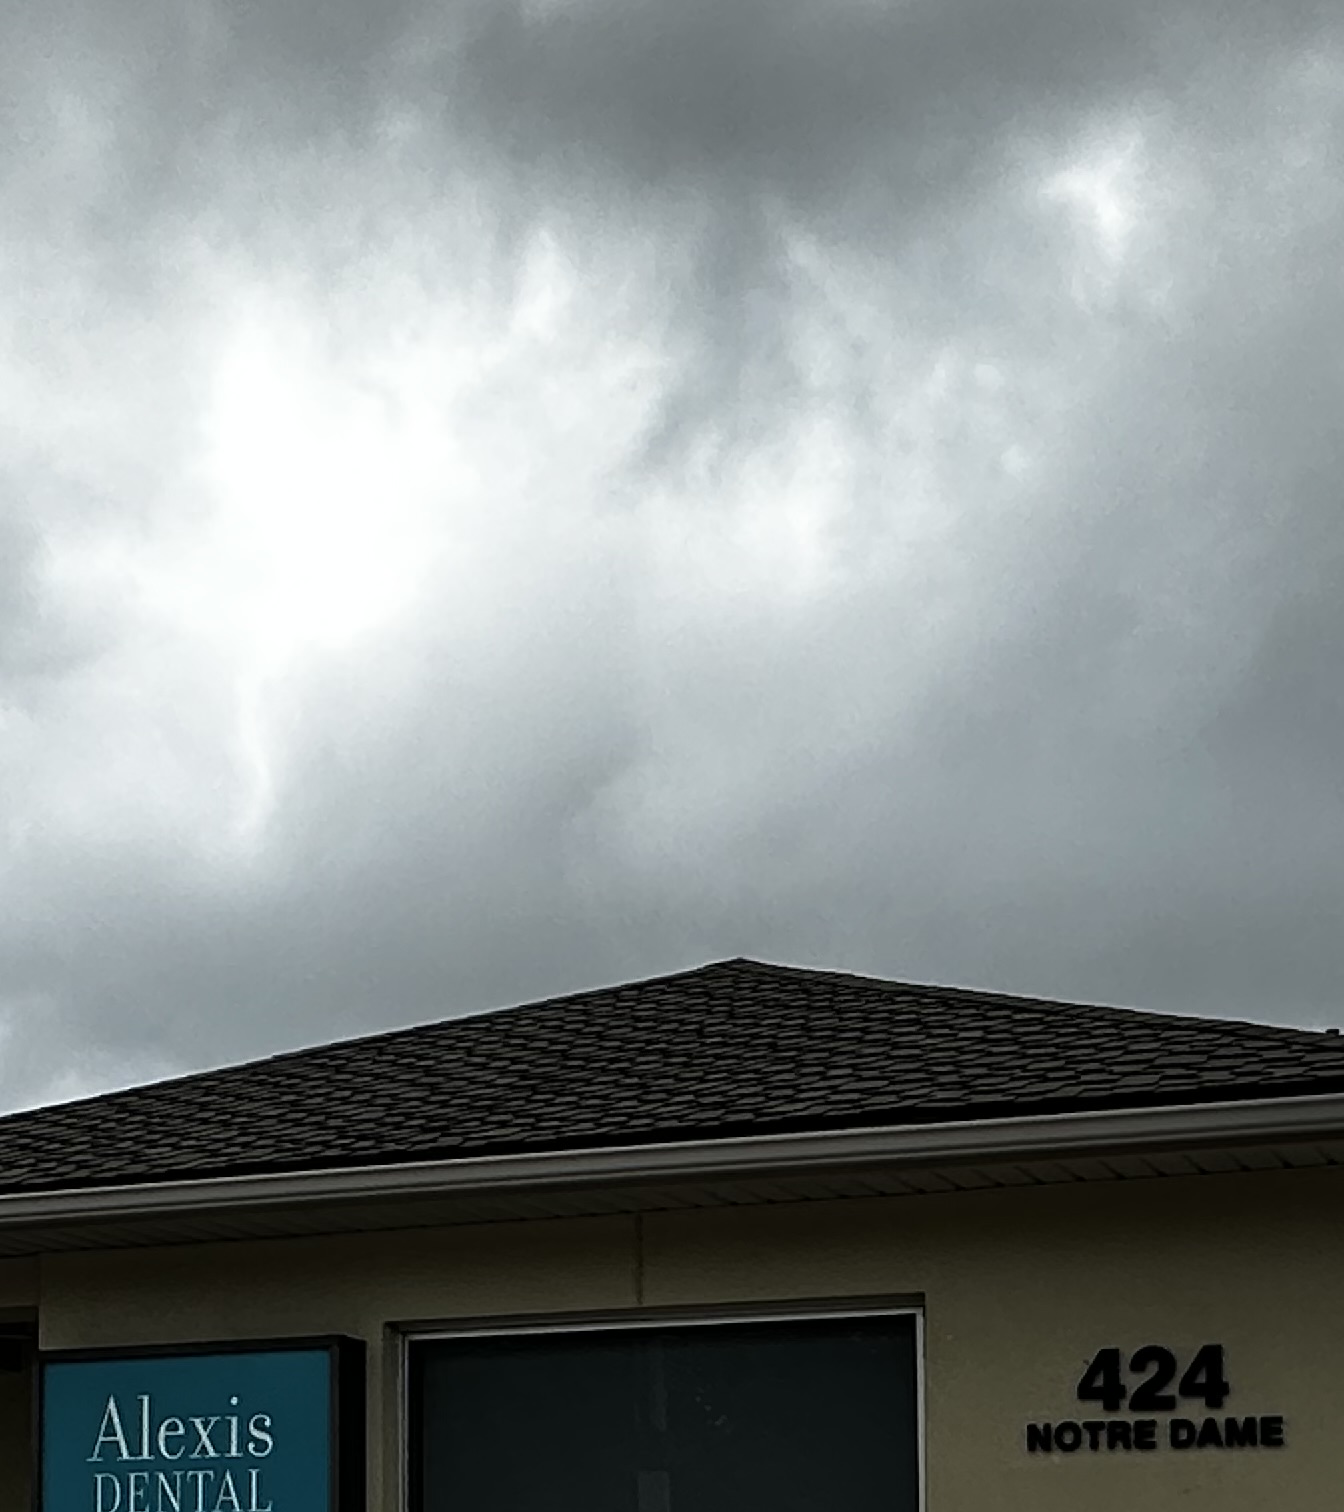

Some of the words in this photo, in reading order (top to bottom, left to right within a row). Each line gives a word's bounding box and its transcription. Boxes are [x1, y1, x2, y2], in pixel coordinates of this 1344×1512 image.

[1077, 1344, 1229, 1412] 424
[86, 1394, 274, 1462] Alexis
[1026, 1419, 1157, 1451] NOTRE
[1168, 1416, 1284, 1449] DAME
